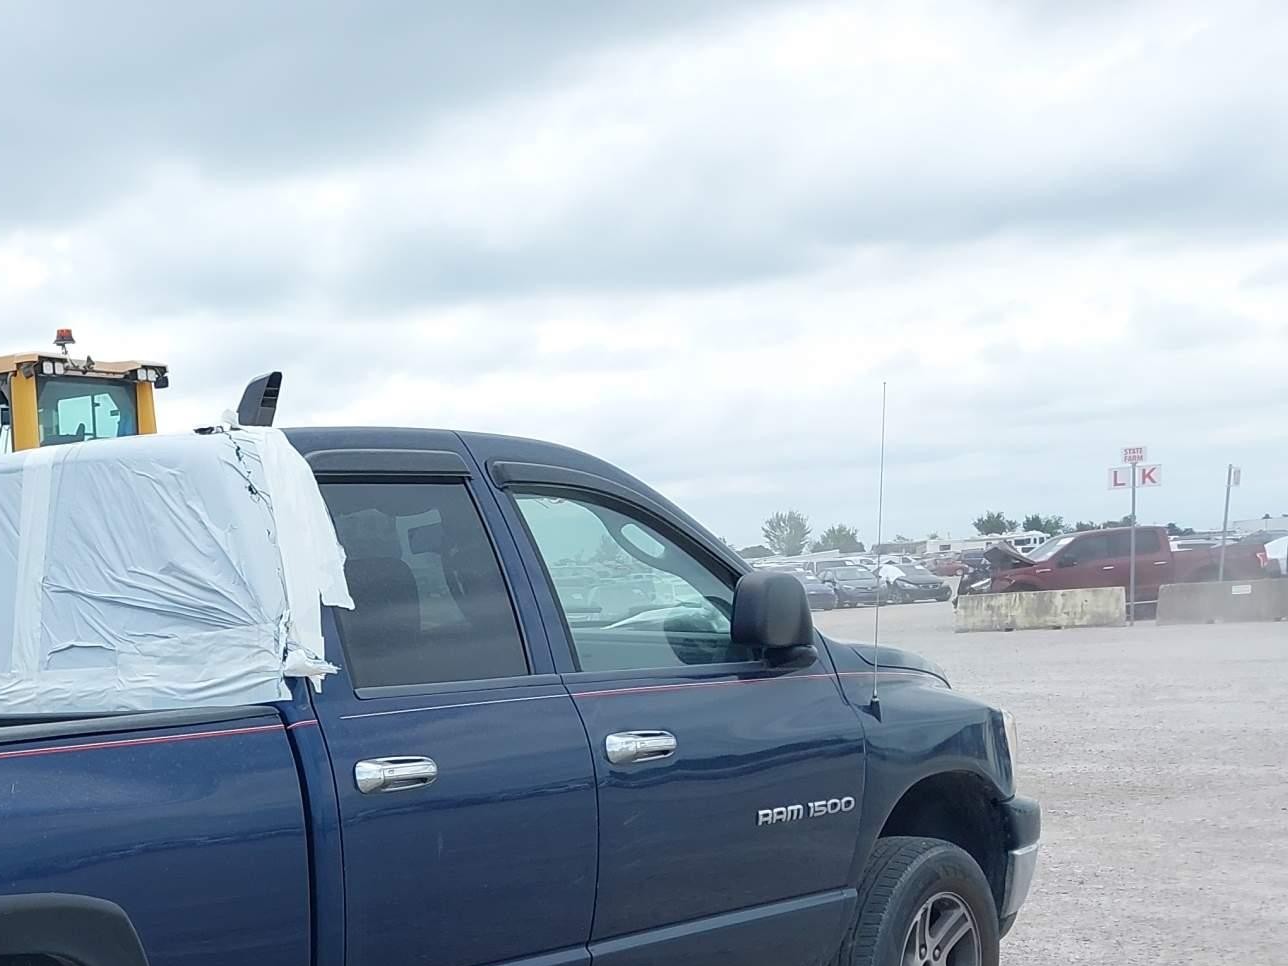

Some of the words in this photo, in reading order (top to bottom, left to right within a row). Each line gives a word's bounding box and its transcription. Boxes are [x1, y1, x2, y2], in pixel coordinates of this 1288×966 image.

[1123, 447, 1142, 455] STATE
[1124, 455, 1143, 463] FARM
[1113, 471, 1126, 486] L
[1142, 467, 1156, 484] K
[757, 804, 803, 826] RAM
[808, 796, 855, 817] 1500
